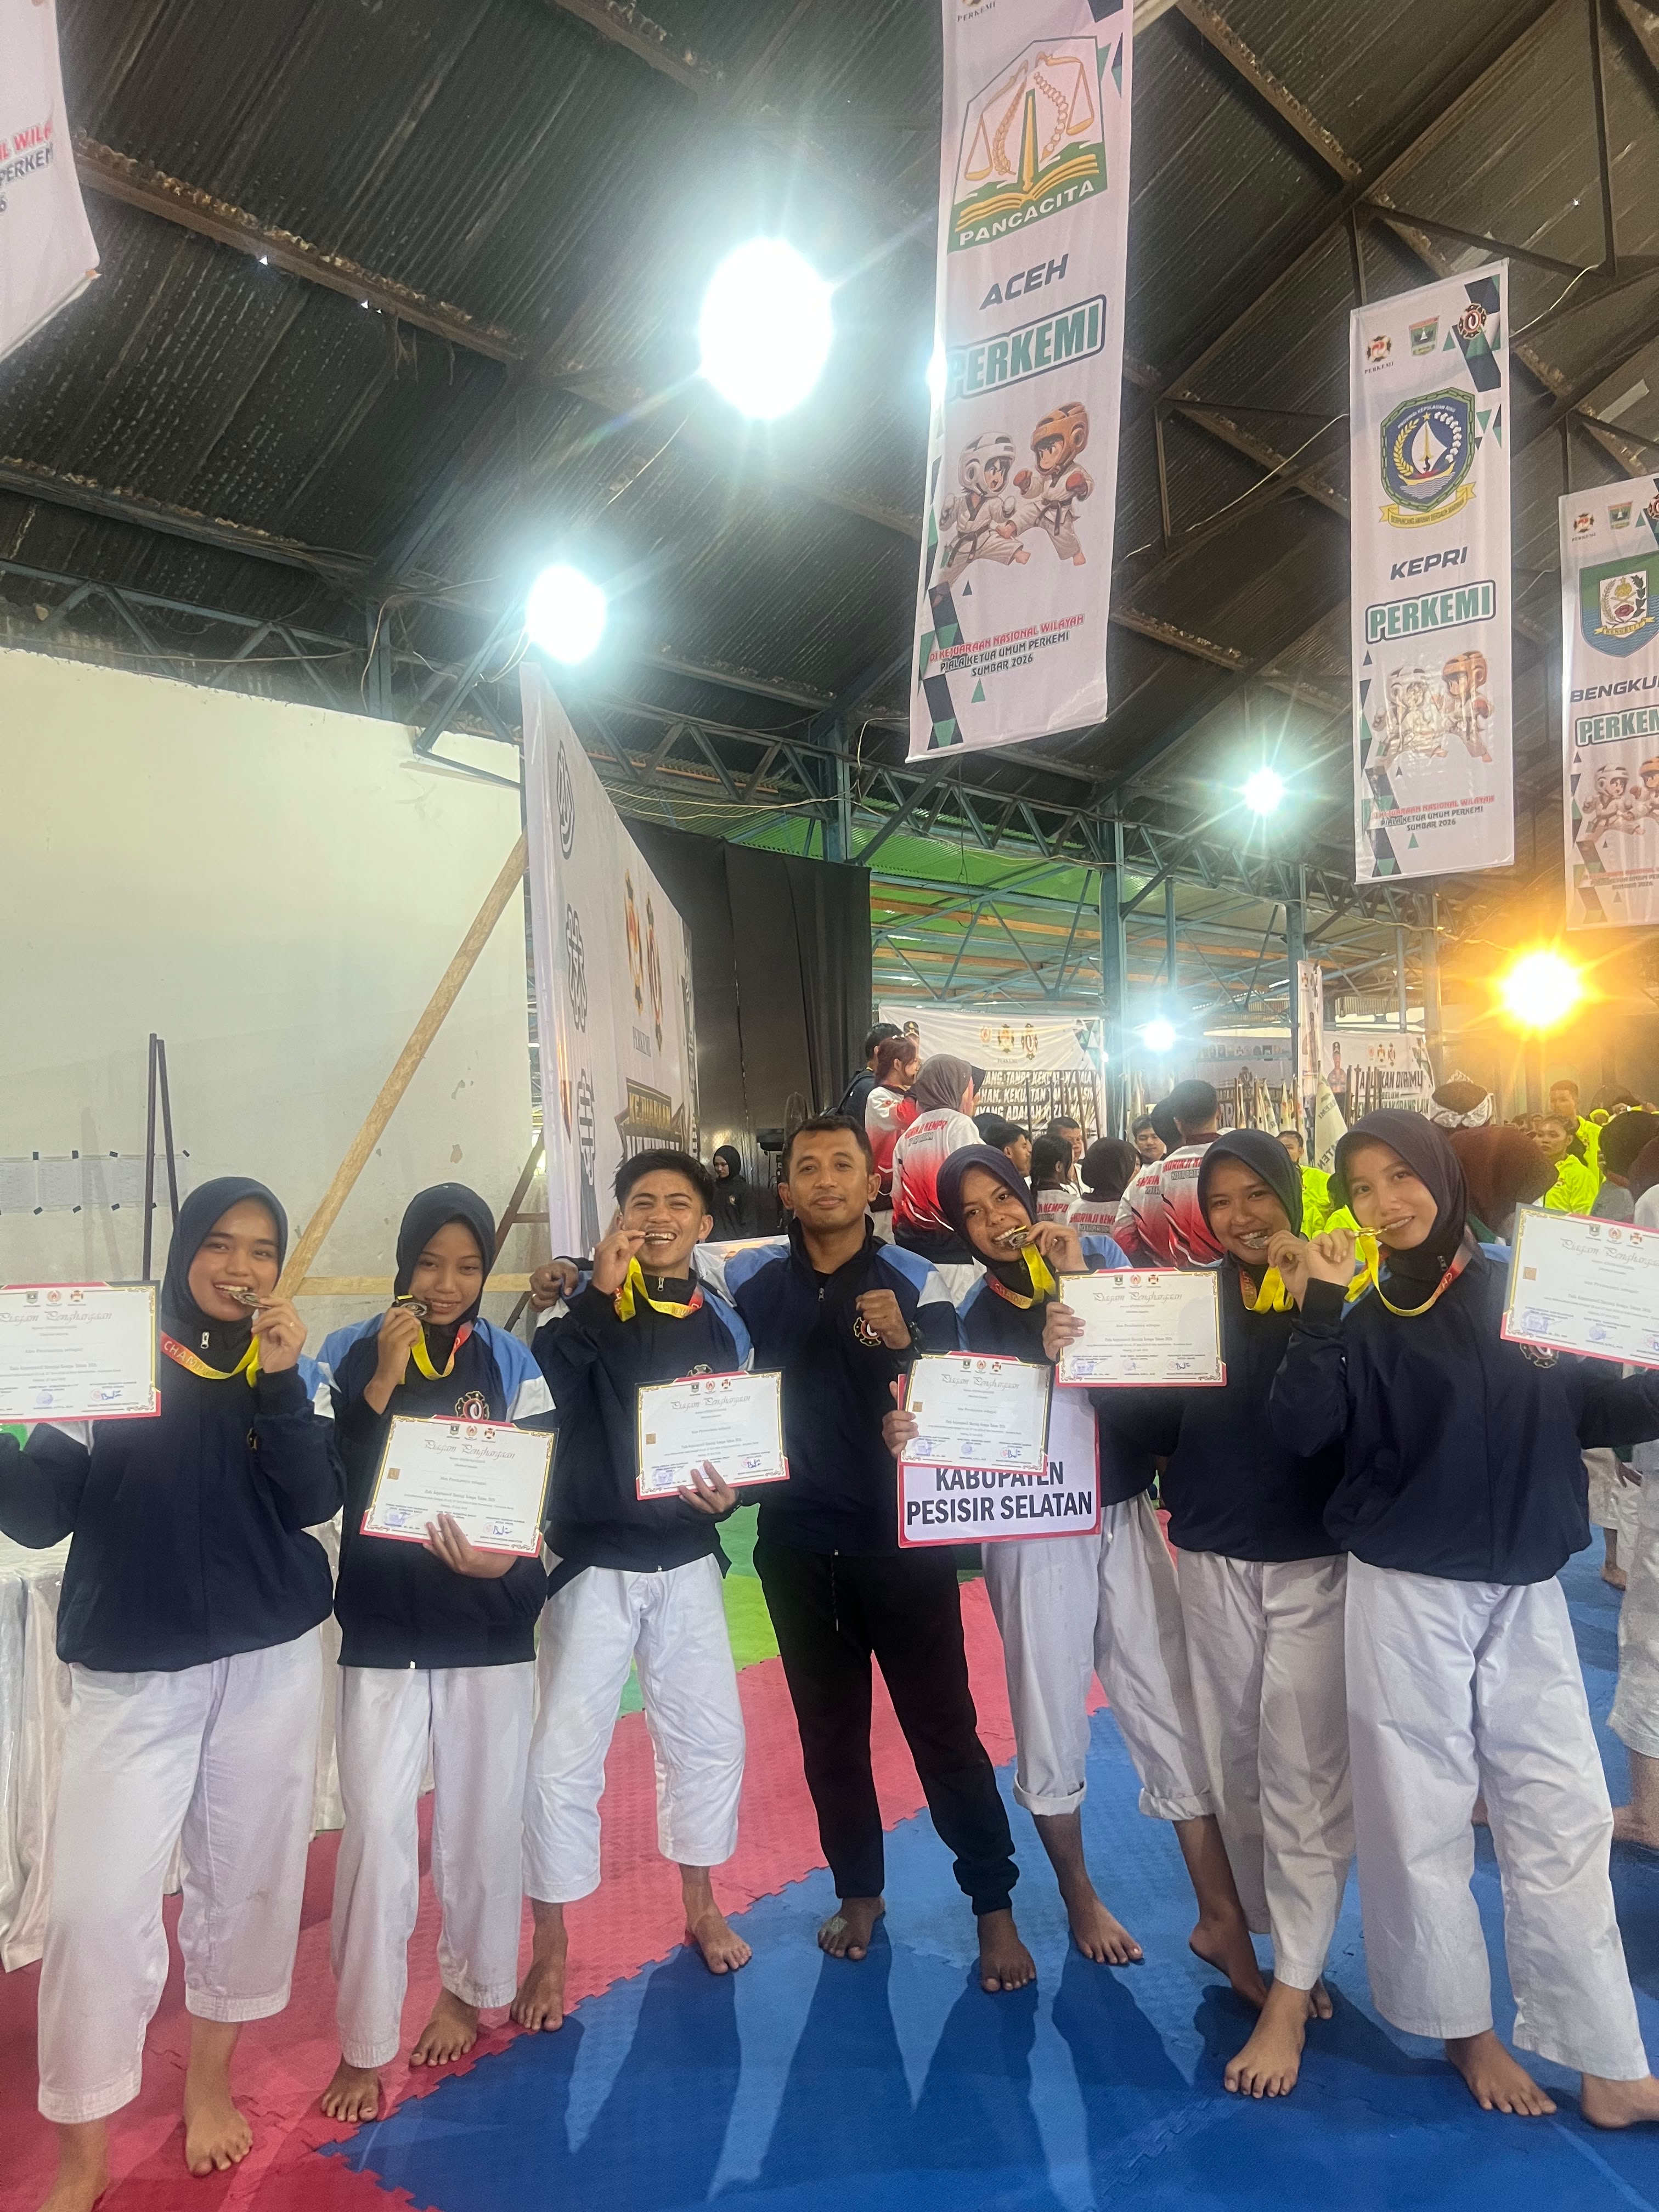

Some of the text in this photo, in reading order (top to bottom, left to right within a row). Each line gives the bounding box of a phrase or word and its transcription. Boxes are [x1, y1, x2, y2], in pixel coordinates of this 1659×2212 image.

[960, 180, 1094, 245] PANCACITA
[979, 253, 1069, 311] ACEH
[946, 303, 1099, 396] PERKEMI
[1390, 546, 1468, 580] KEPRI
[1370, 585, 1490, 639] PERKEMI
[939, 639, 990, 659] KEJUARAAN
[994, 627, 1037, 644] NASIONAL
[1040, 614, 1084, 633] WILAYAH
[940, 631, 1069, 672] PIALA KETUA UMUM PERKEMI
[971, 653, 1033, 677] SUMBAR 2026
[1570, 675, 1659, 703] BENGKU
[1403, 814, 1426, 823] KETUA
[1427, 811, 1450, 820] UMUM
[1452, 806, 1484, 817] PERKEMI
[1423, 801, 1459, 812] NASIONAL
[1460, 795, 1495, 808] WILAYAH
[1407, 818, 1457, 831] SUMBAR 2026
[1003, 1088, 1047, 1103] KEKUTAN
[1043, 1203, 1070, 1214] KEMPO
[1093, 1291, 1183, 1304] Piagam Penghargaan
[425, 1439, 516, 1461] Piagam Penghargaan
[907, 1491, 1092, 1526] PESISIR SELATAN
